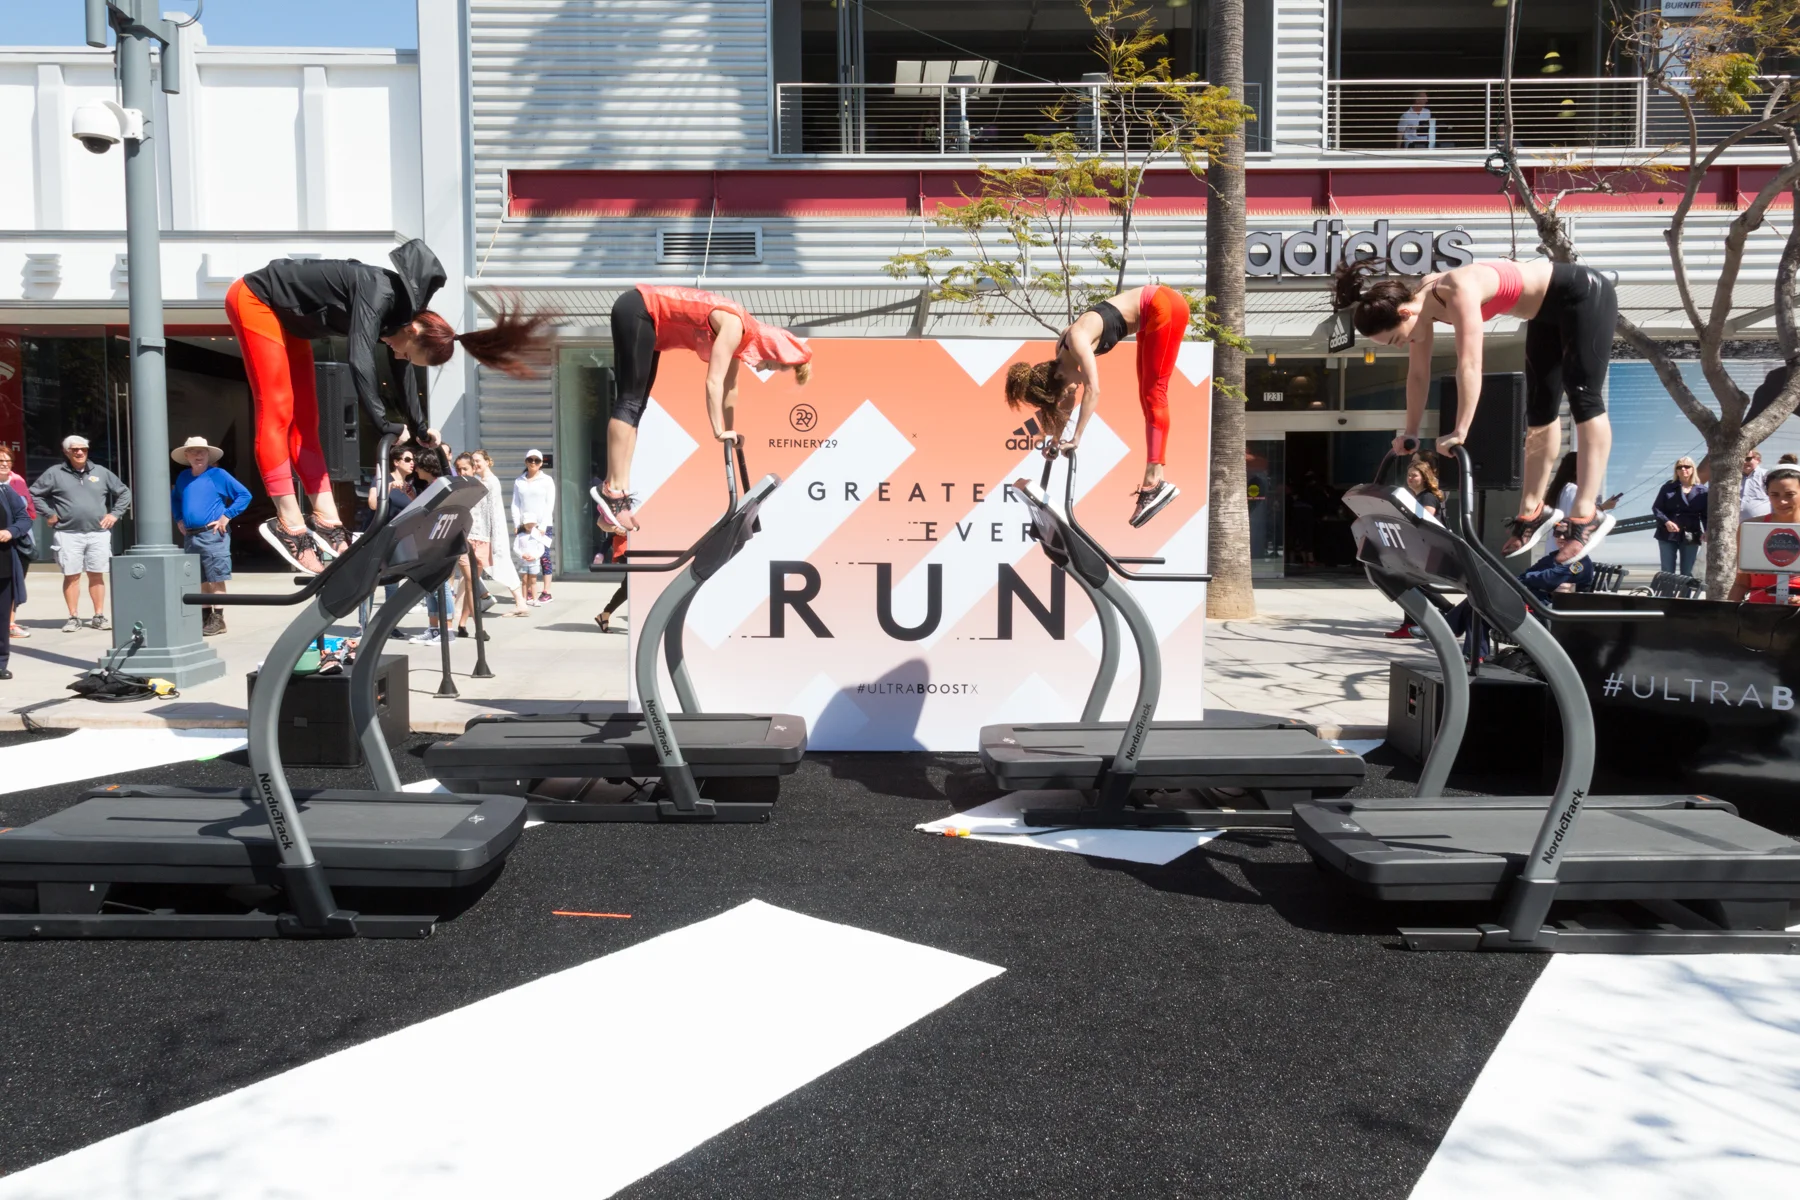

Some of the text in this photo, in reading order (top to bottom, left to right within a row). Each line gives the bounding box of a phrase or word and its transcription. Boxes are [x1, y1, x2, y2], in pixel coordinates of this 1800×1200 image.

[1245, 219, 1474, 276] adidas
[1330, 334, 1348, 348] adidas
[1264, 392, 1283, 401] 1231
[768, 438, 839, 449] REFINERY29
[807, 481, 1020, 503] GREATER
[925, 521, 1038, 542] EVER
[769, 560, 1066, 641] RUN
[857, 683, 979, 695] #ULTRABOOSTX
[1602, 672, 1795, 711] #ULTRAB
[646, 699, 673, 757] NordicTrack
[1125, 703, 1152, 761] NordicTrack
[258, 772, 294, 850] NordicTrack
[1541, 788, 1585, 865] NordicTrack
